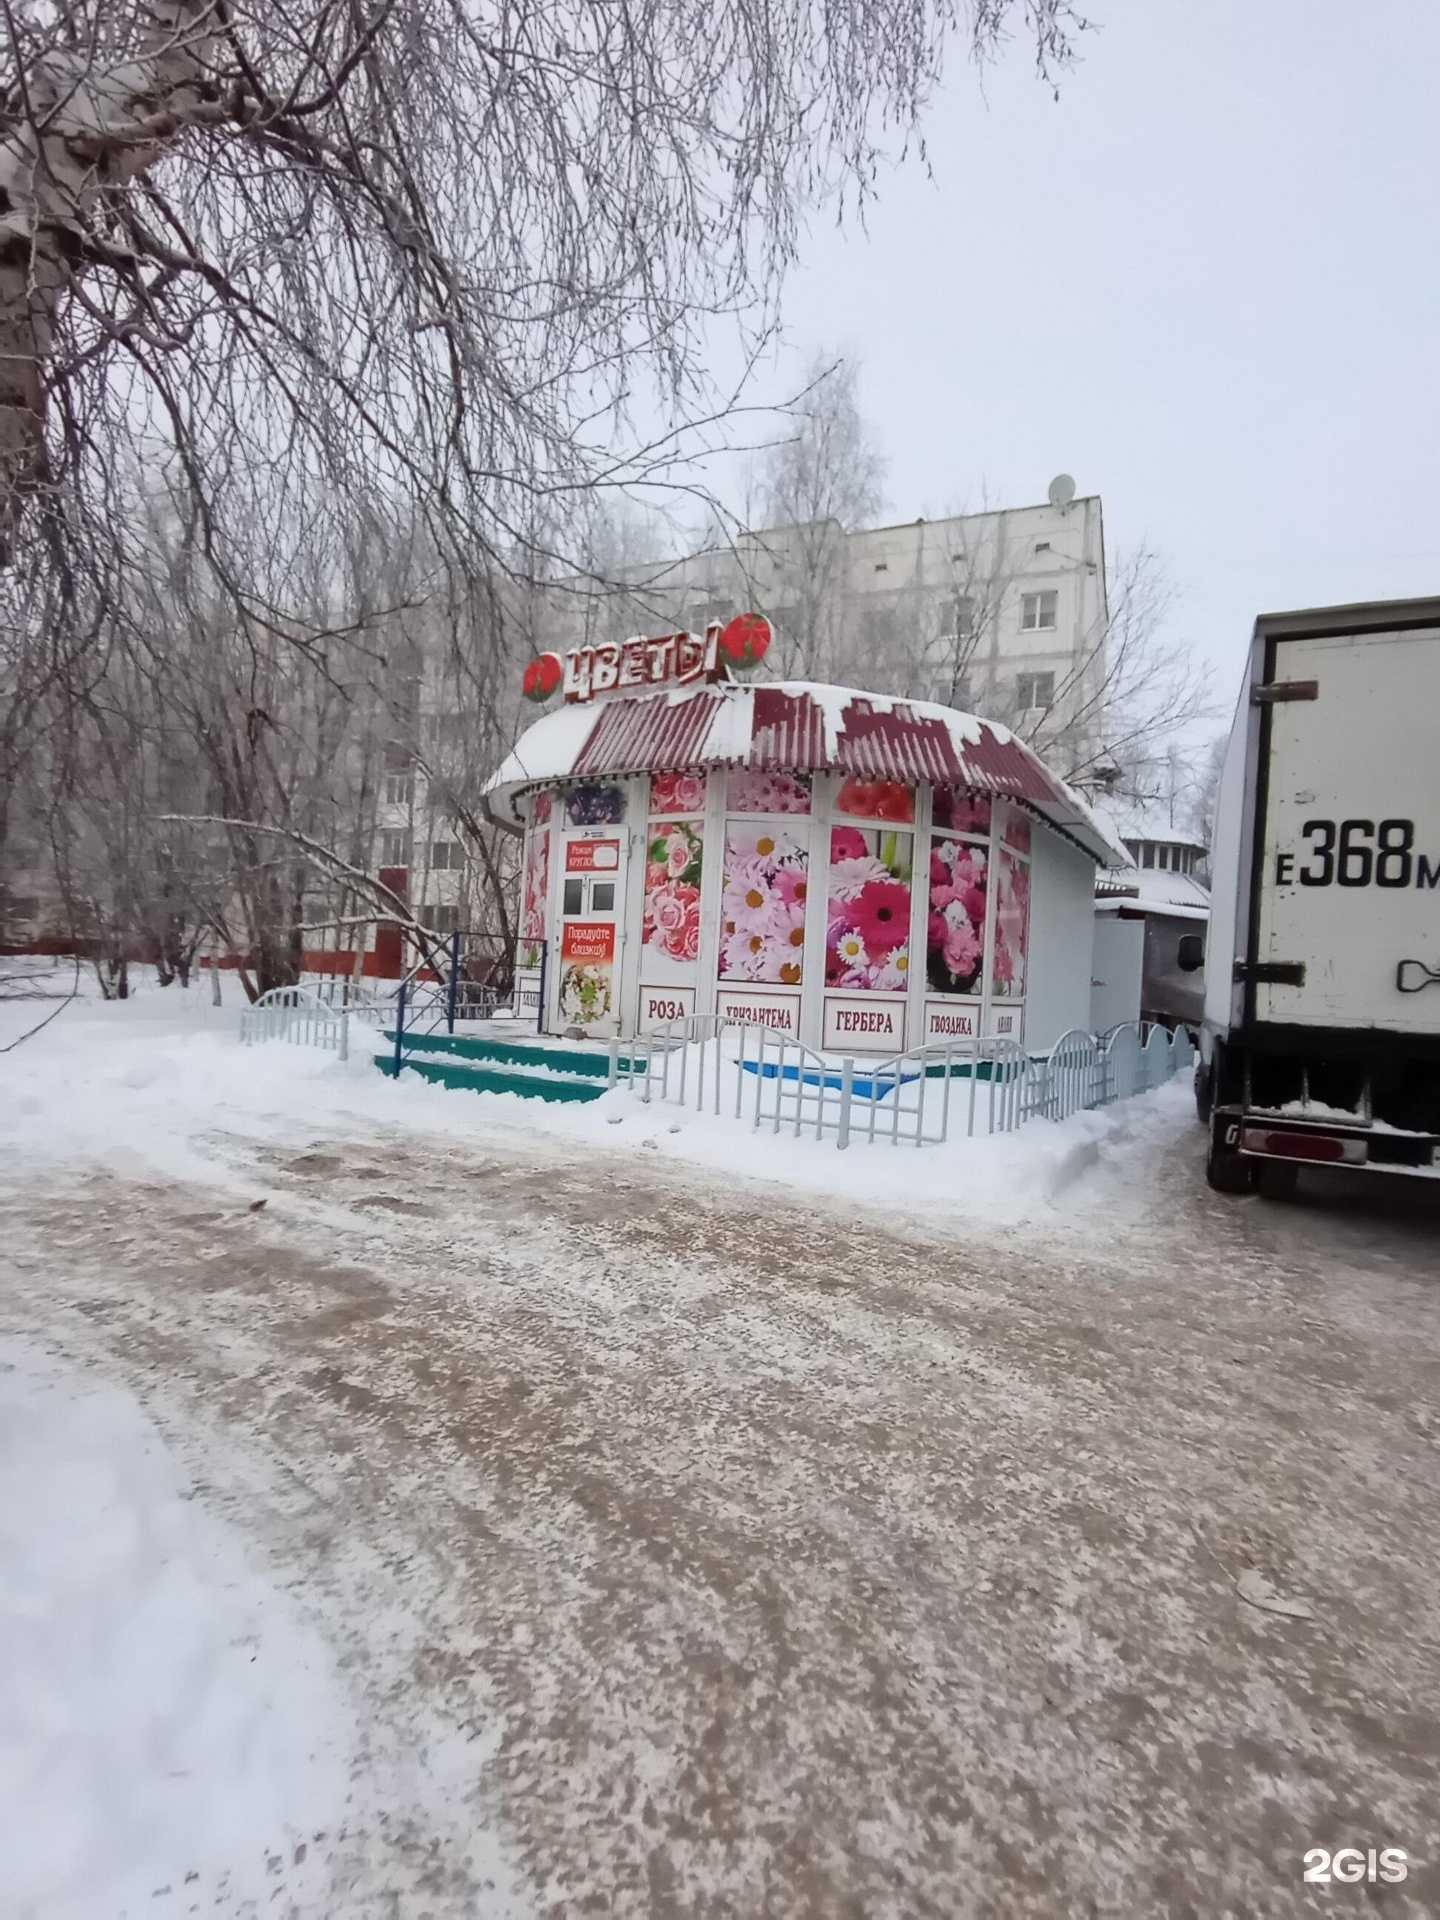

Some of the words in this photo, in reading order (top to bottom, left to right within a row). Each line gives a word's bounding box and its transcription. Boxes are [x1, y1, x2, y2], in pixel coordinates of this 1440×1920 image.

[563, 620, 724, 703] ЦВЕТЫ
[568, 926, 610, 941] Порадуйте
[649, 1000, 684, 1020] РОЗА
[836, 1011, 893, 1033] ГЕРБЕРА
[930, 1015, 972, 1035] ГВОЗДИКА
